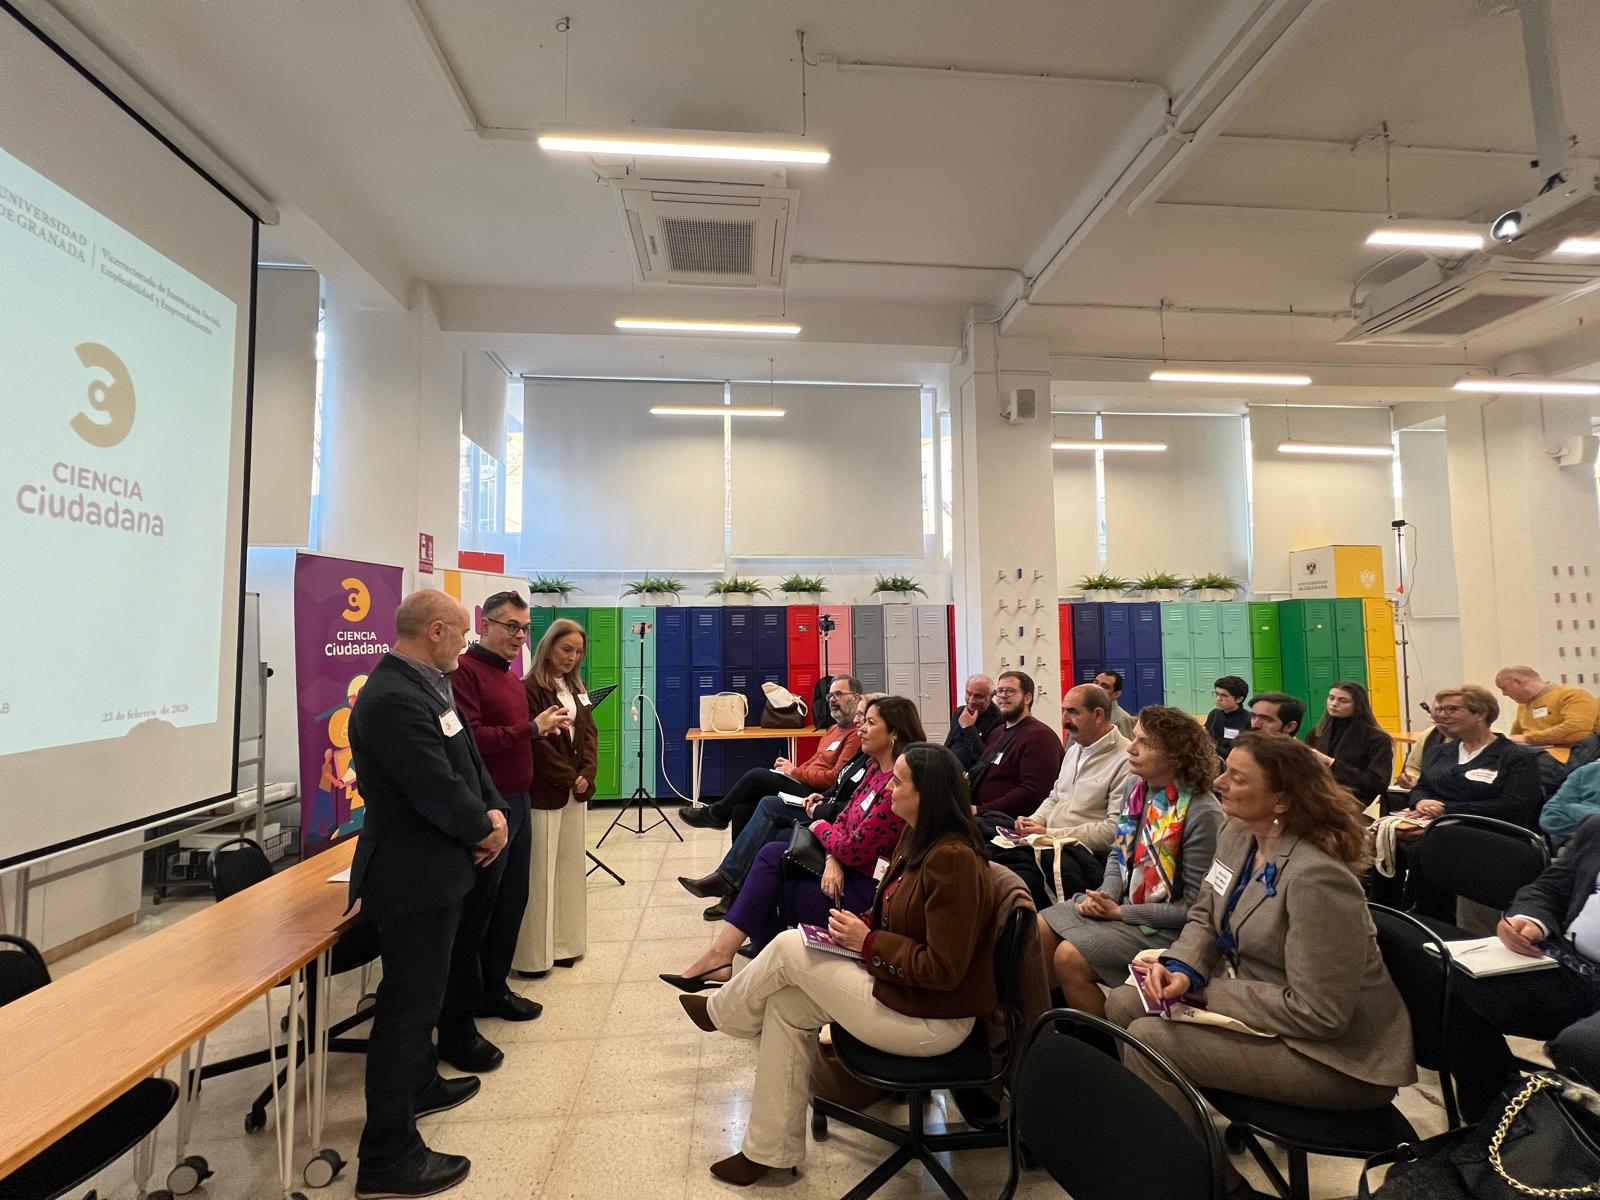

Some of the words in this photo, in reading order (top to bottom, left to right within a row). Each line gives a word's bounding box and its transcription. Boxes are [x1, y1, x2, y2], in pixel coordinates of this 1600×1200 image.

[0, 185, 88, 247] UNIVERSIDAD
[16, 213, 87, 264] GRANADA
[52, 462, 143, 501] CIENCIA
[16, 483, 164, 537] Ciudadana
[324, 641, 390, 657] Ciudadana
[336, 631, 377, 641] CIENCIA
[115, 711, 125, 721] de
[161, 704, 170, 715] de
